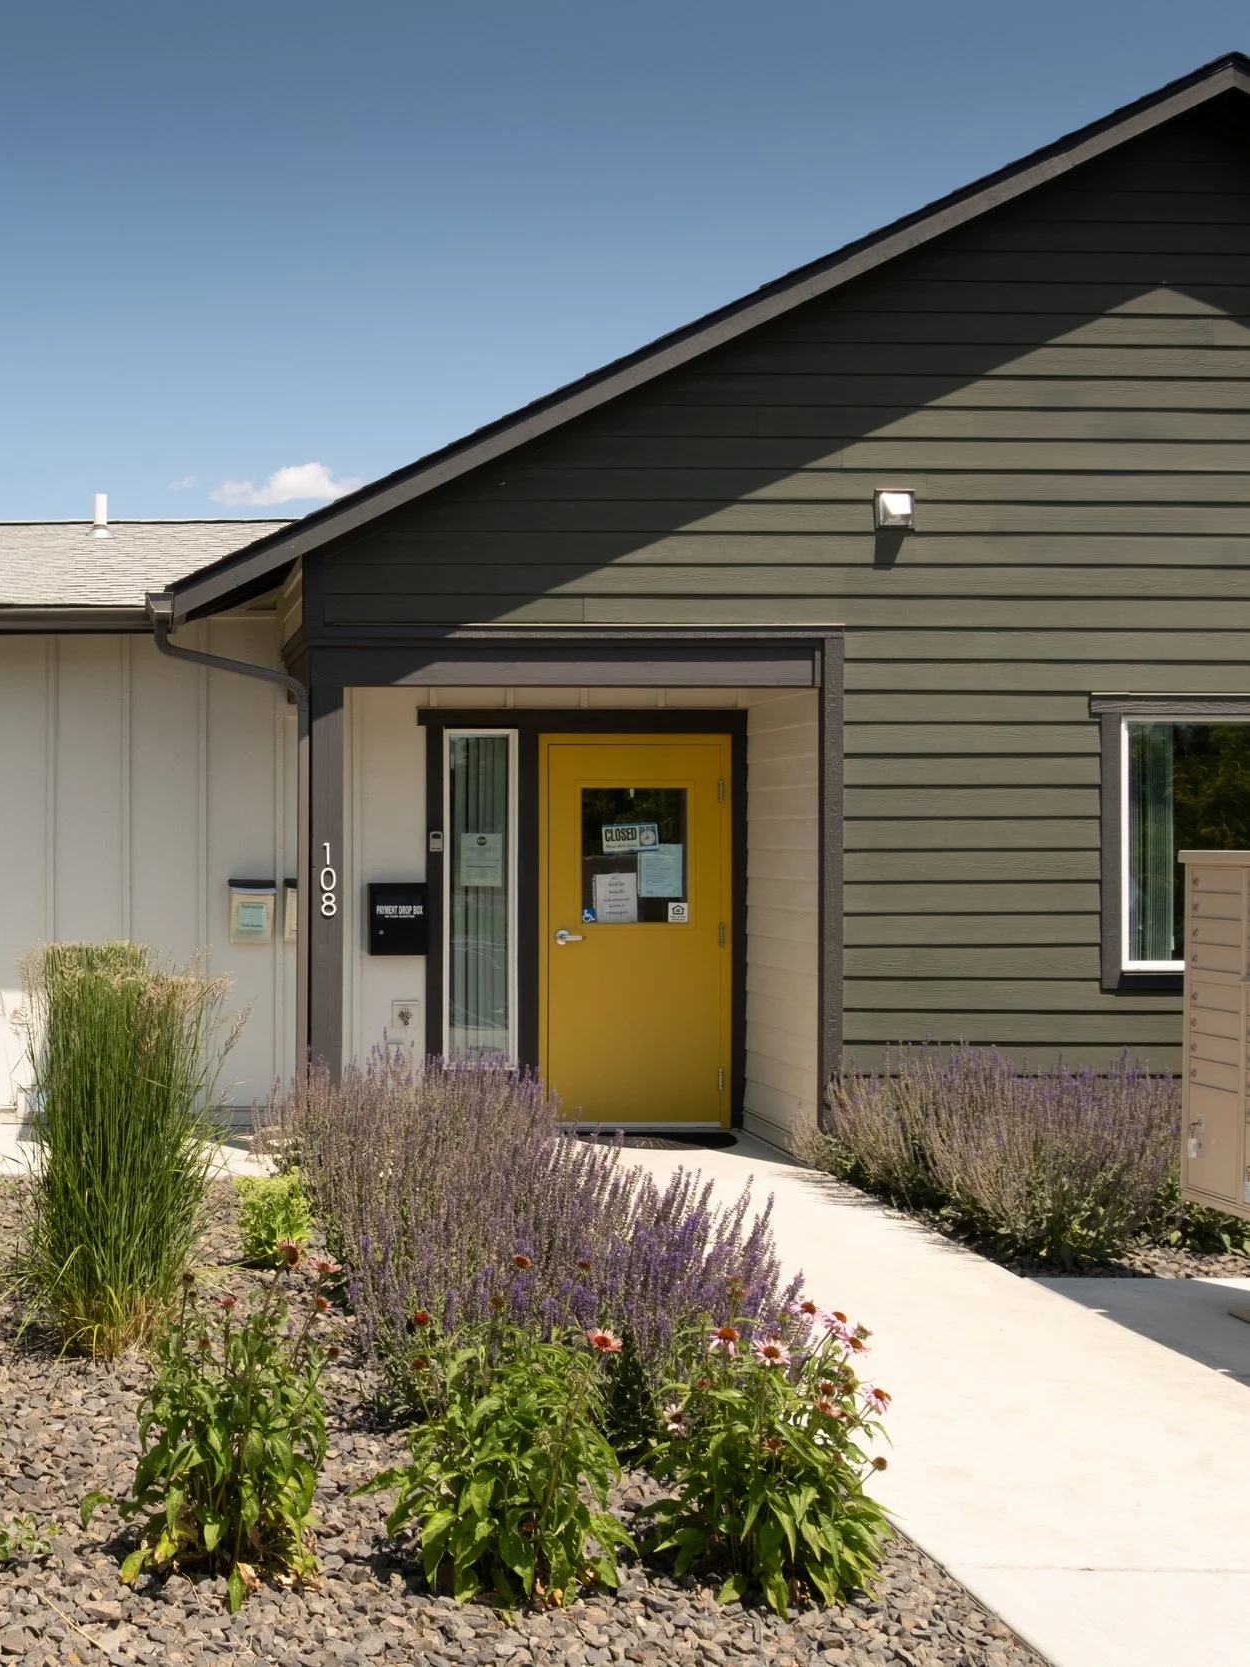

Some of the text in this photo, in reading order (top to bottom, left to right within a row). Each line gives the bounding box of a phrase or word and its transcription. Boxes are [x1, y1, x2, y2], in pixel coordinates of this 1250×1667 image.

[604, 828, 637, 842] CLOSED
[320, 842, 337, 916] 108
[376, 905, 424, 914] PAYMENT DROP BOX
